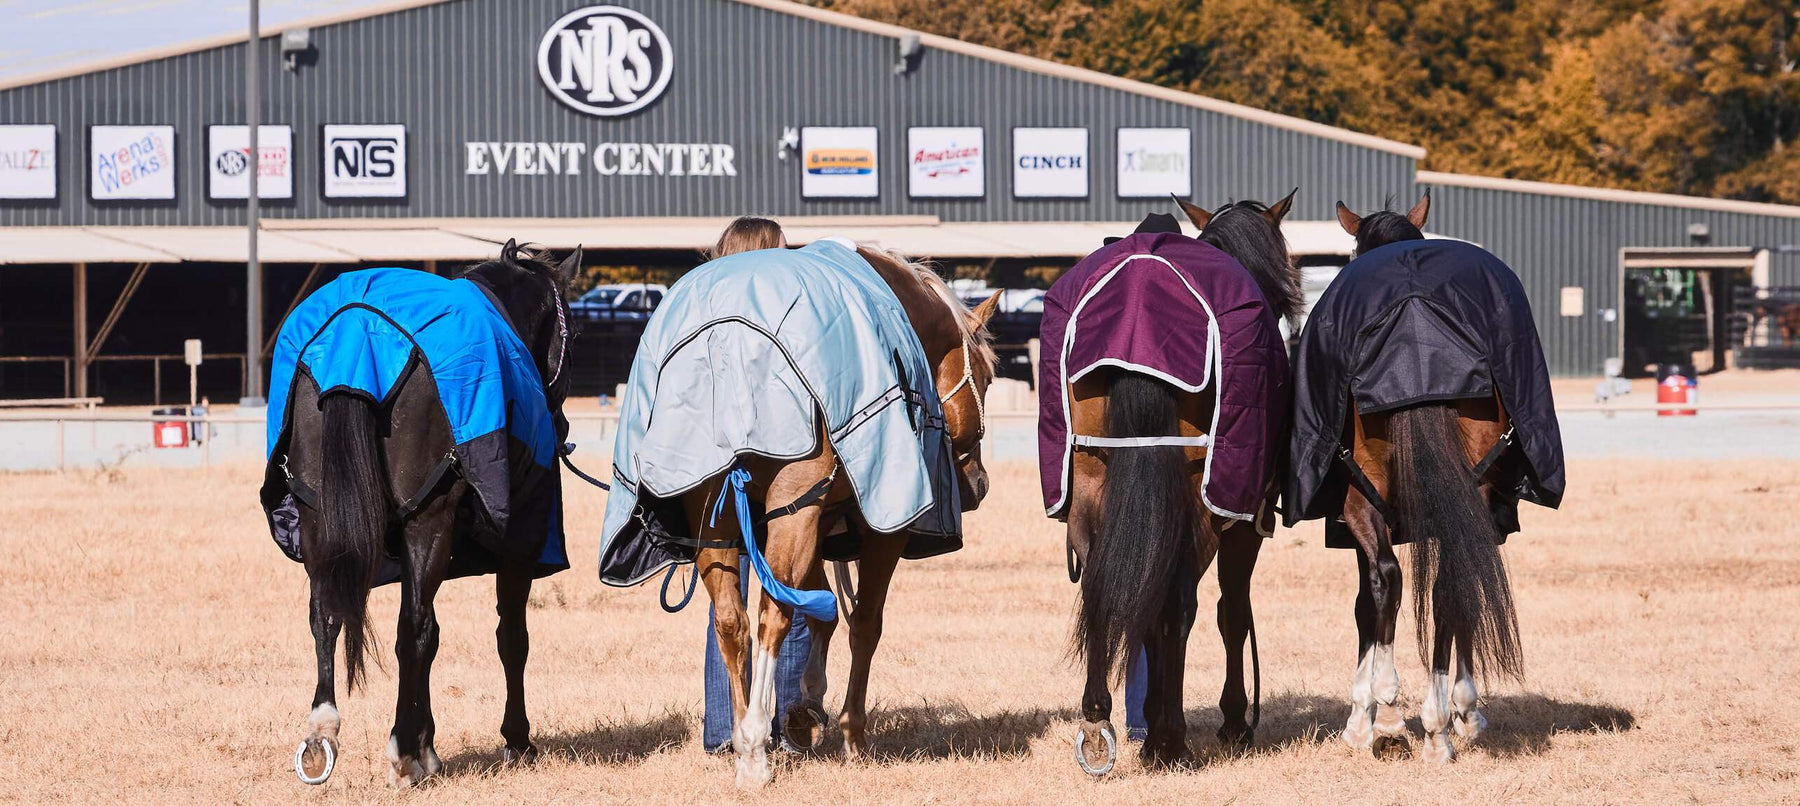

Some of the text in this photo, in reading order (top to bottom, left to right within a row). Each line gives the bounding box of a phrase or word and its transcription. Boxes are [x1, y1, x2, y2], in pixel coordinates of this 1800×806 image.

[558, 16, 652, 102] NRS
[0, 149, 52, 170] ALIZE
[99, 136, 153, 171] Arena
[219, 151, 245, 175] NRS
[331, 138, 398, 177] NTS
[465, 142, 737, 176] EVENT CENTER
[914, 147, 979, 165] American
[1019, 156, 1081, 169] CINCH
[1139, 148, 1185, 175] Smarty
[100, 157, 160, 192] Werks
